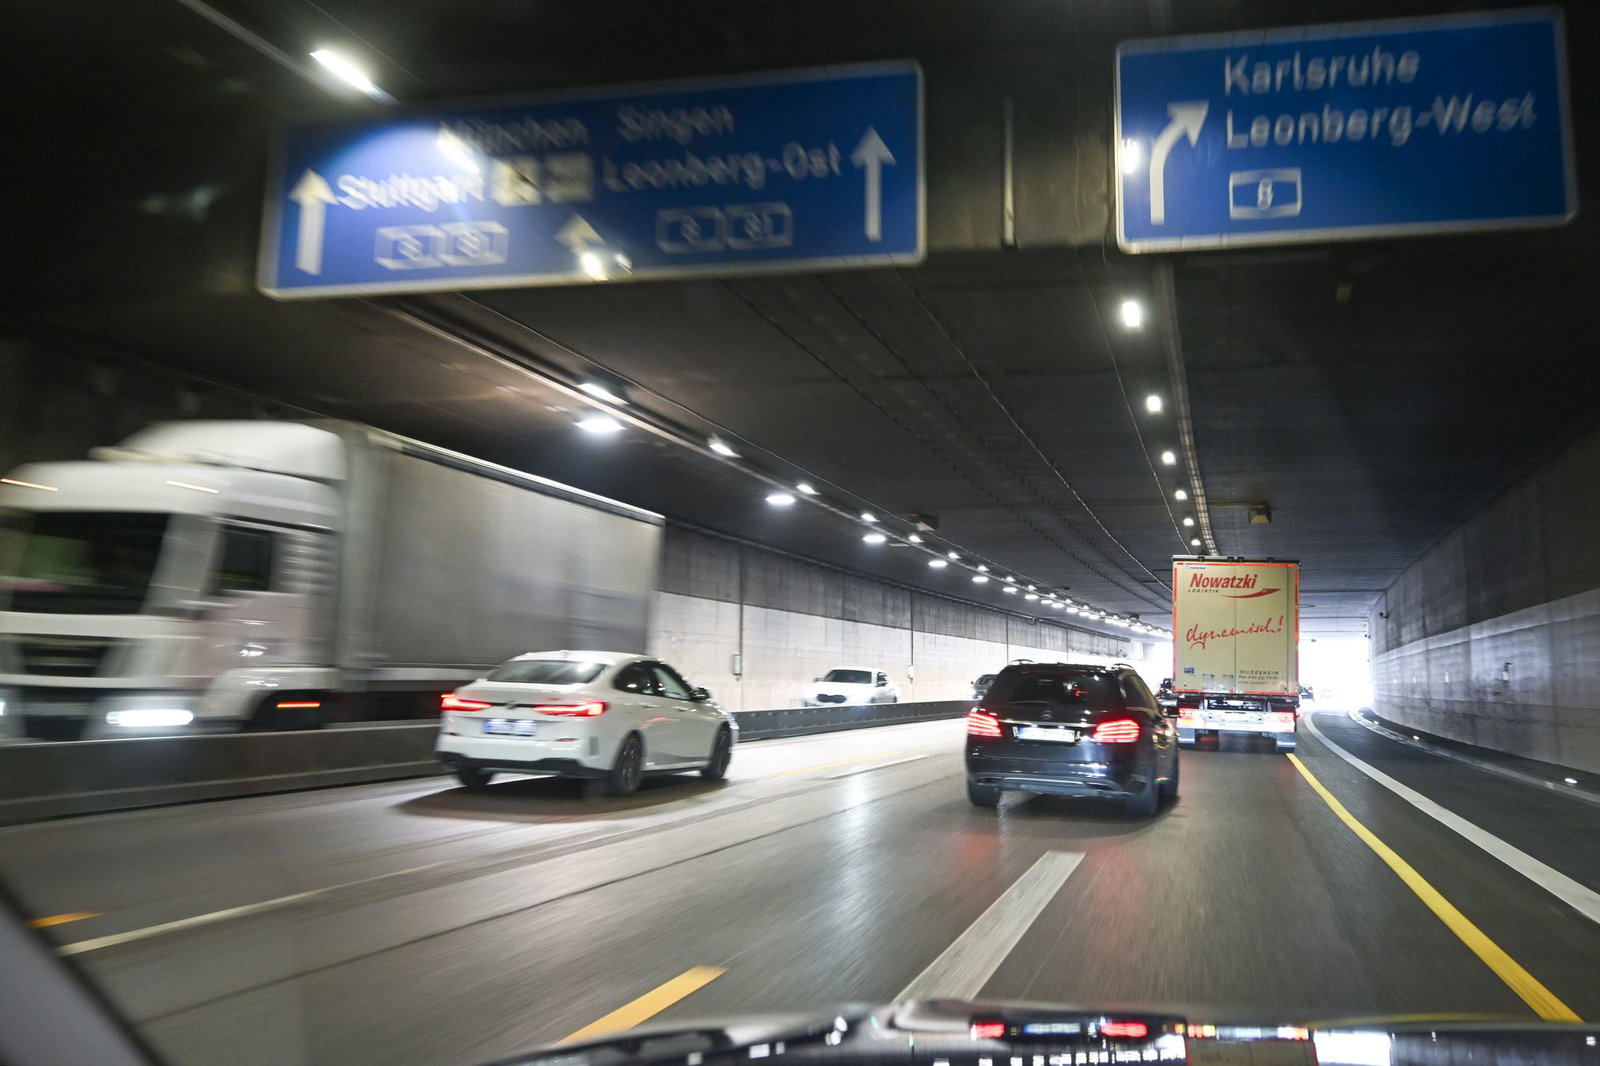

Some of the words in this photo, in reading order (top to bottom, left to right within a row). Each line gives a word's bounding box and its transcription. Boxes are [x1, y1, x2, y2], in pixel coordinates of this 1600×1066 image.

[1225, 46, 1420, 96] Karlsruhe
[617, 105, 735, 145] Singen
[1227, 91, 1536, 150] Leonberg-West
[602, 142, 843, 191] Leonberg-Ost
[1189, 573, 1258, 589] Nowatzki
[1186, 615, 1284, 650] dynamisch!
